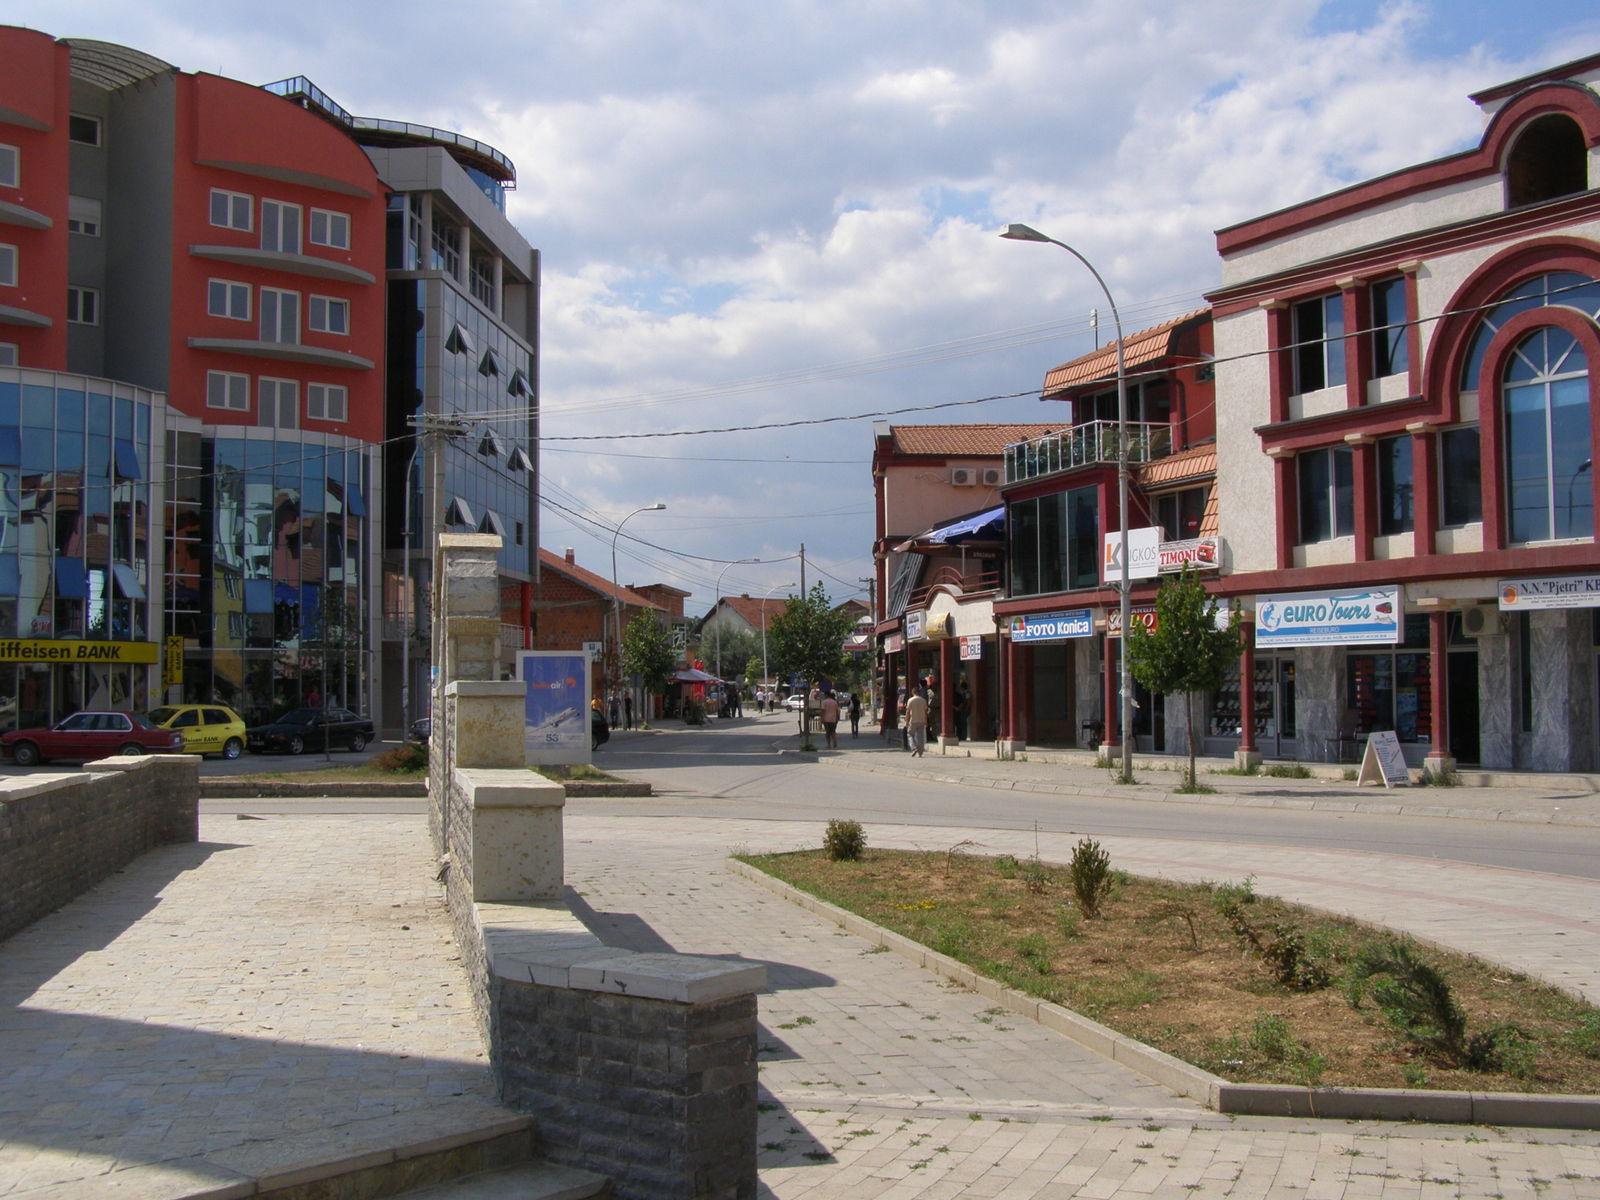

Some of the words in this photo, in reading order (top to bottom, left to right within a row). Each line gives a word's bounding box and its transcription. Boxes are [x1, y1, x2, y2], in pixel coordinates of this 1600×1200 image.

[1160, 549, 1196, 565] TIMONI
[1328, 593, 1372, 621] Tours
[1026, 623, 1055, 637] FOTO
[1057, 619, 1089, 635] Konica
[0, 642, 71, 659] iffeisen
[77, 645, 121, 659] BANK
